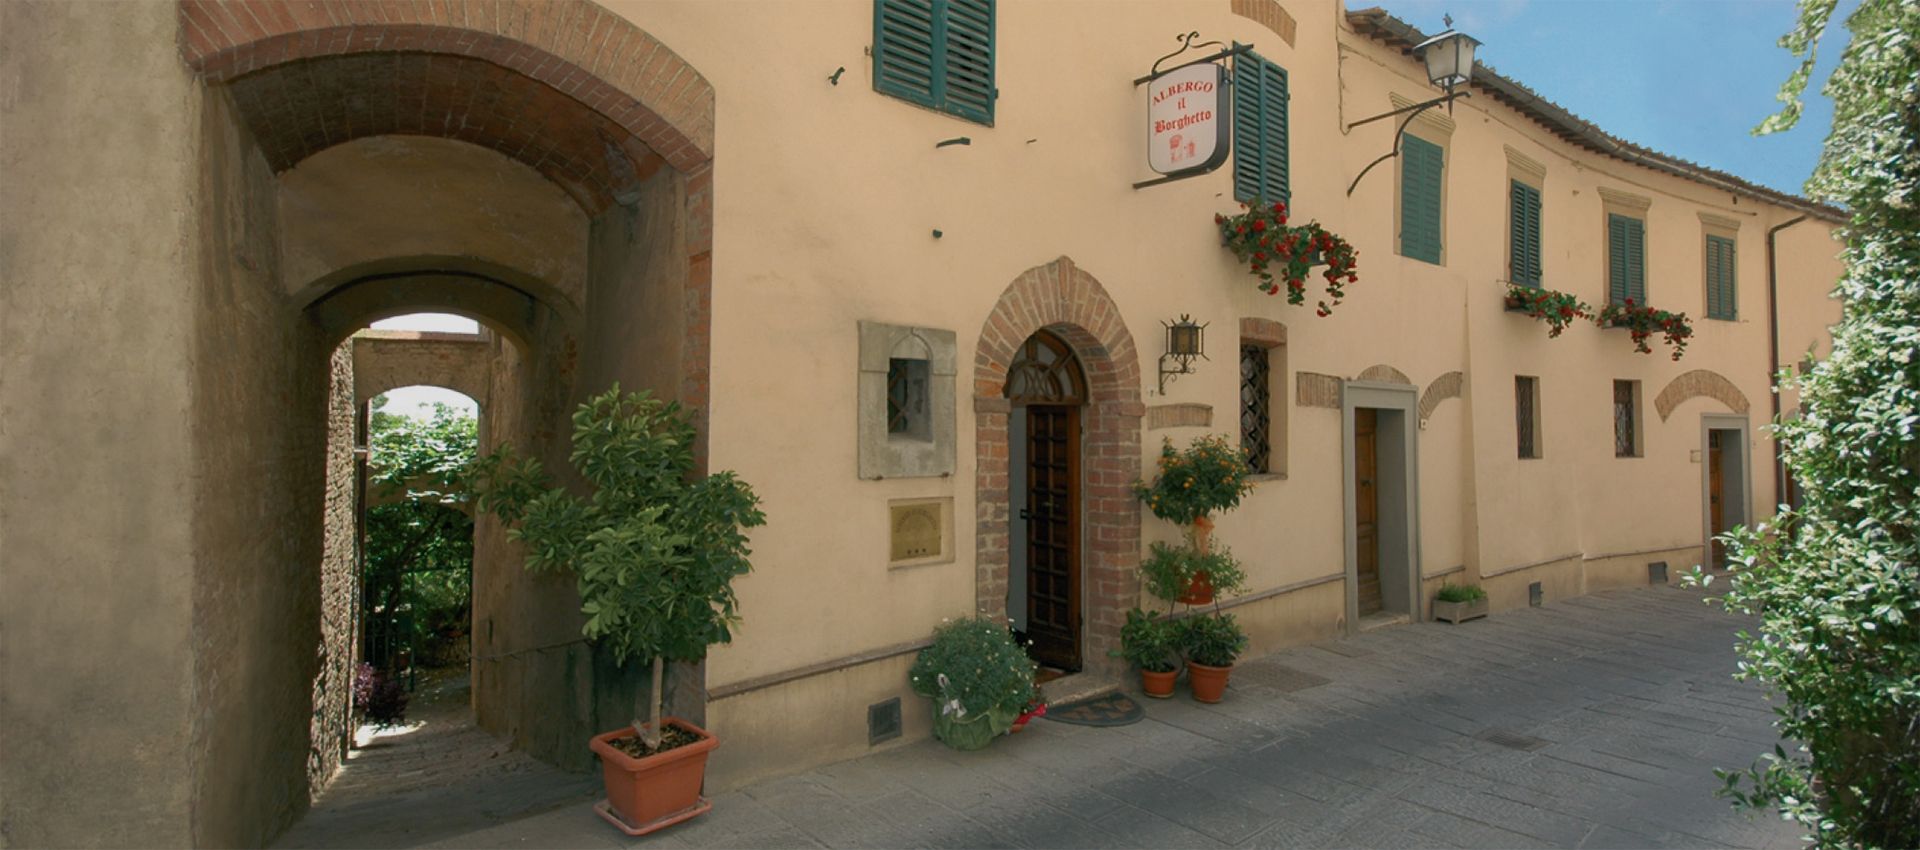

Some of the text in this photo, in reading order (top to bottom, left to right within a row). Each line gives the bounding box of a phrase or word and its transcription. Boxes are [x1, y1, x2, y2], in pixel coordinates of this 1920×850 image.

[1153, 81, 1213, 105] ALBERGO
[1177, 97, 1186, 110] il
[1155, 110, 1211, 133] Borghetto
